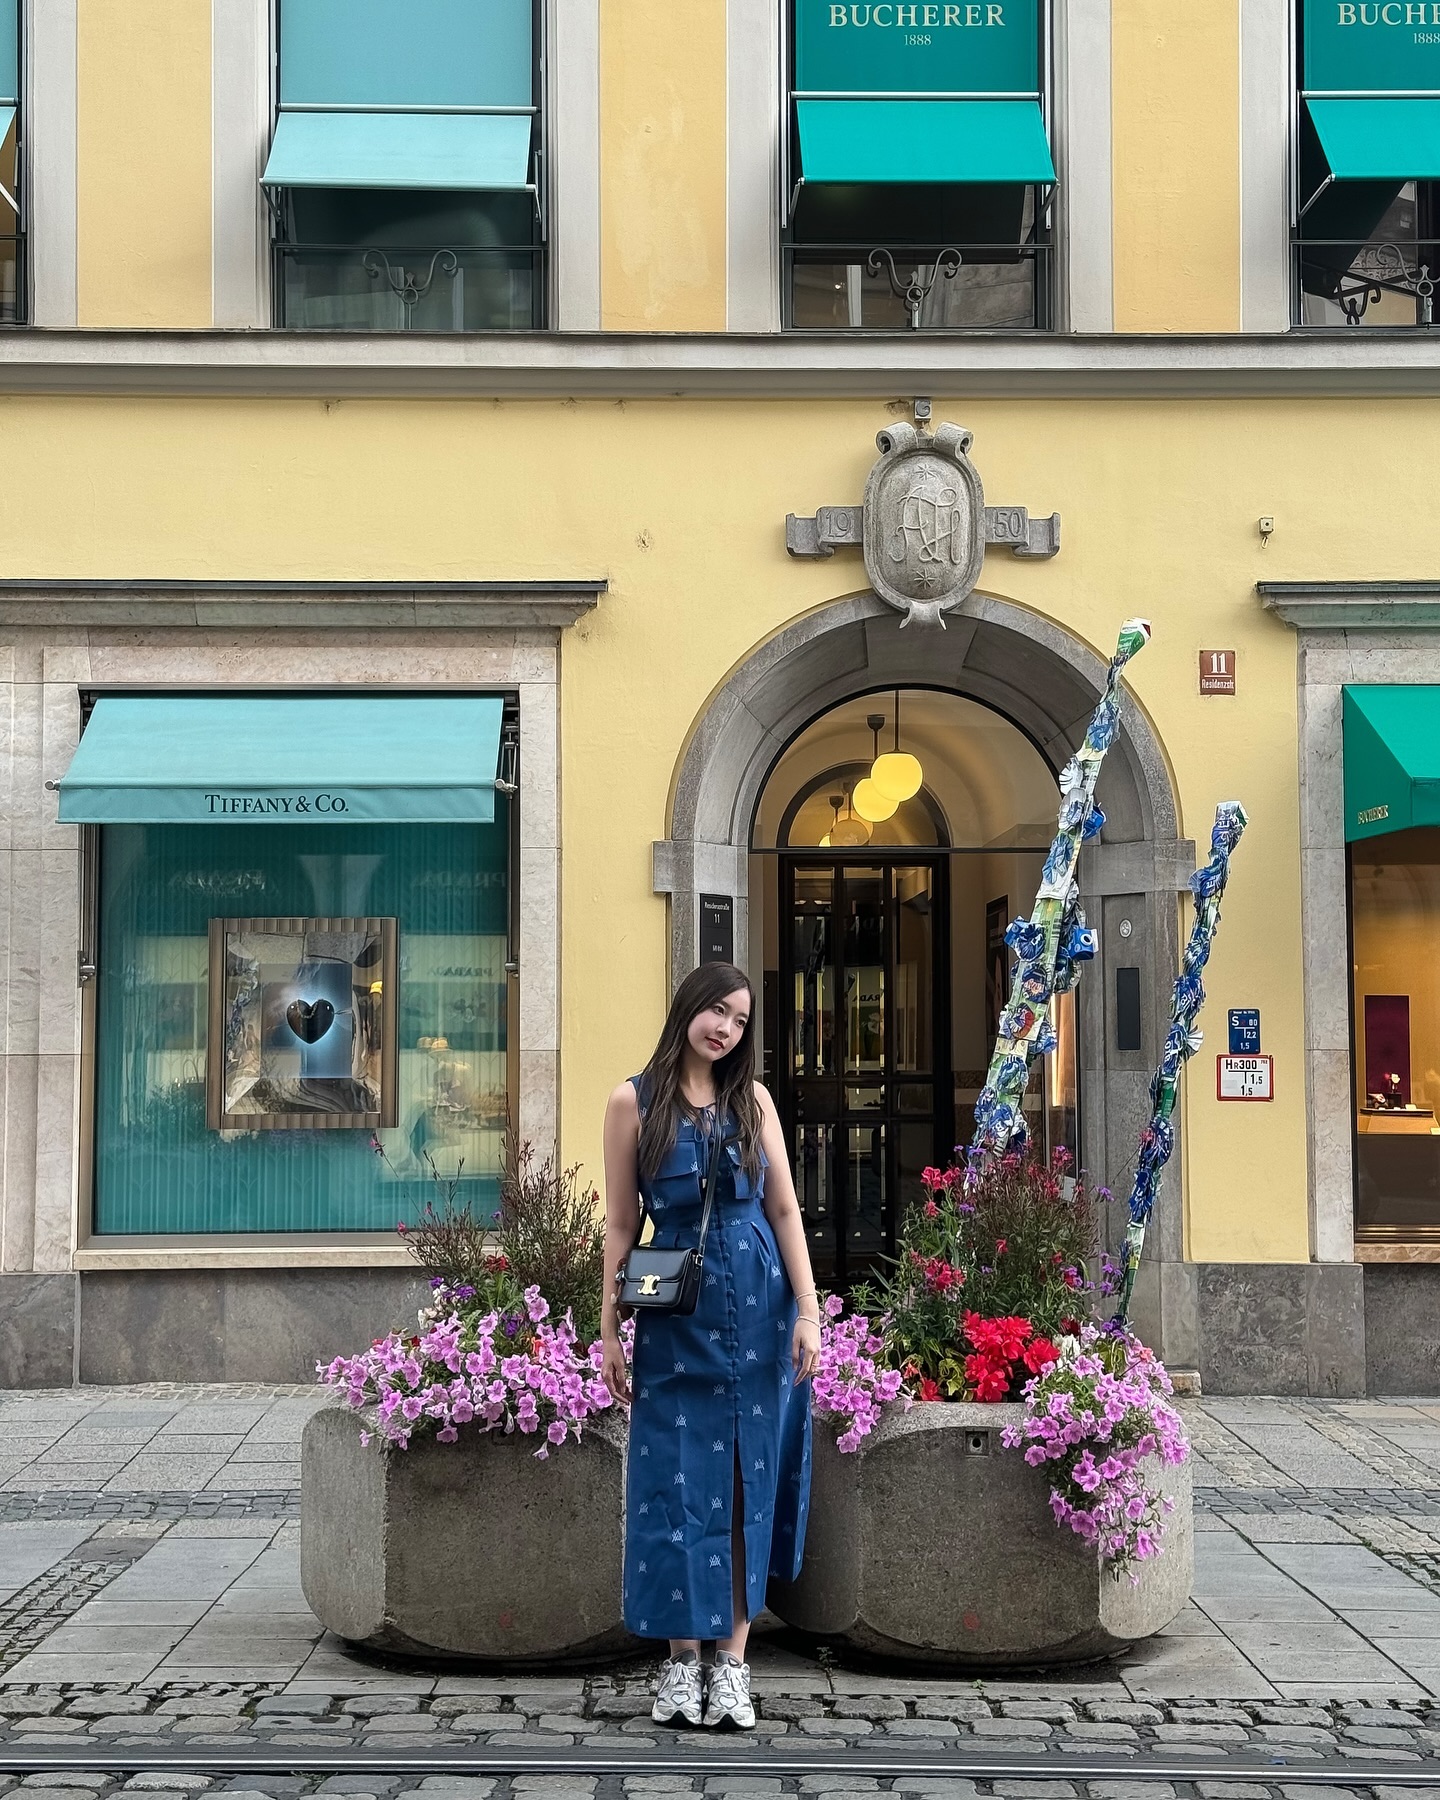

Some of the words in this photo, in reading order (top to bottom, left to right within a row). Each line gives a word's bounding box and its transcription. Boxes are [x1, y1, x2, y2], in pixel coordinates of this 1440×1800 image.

[828, 4, 1006, 27] BUCHERER
[904, 34, 932, 46] 1888
[1413, 33, 1440, 44] 1888
[1210, 652, 1227, 674] 11
[714, 913, 721, 924] 11
[1231, 1015, 1240, 1027] S
[1240, 1042, 1250, 1050] 1,5
[1250, 1073, 1263, 1085] 1,5
[1240, 1085, 1253, 1096] 1,5
